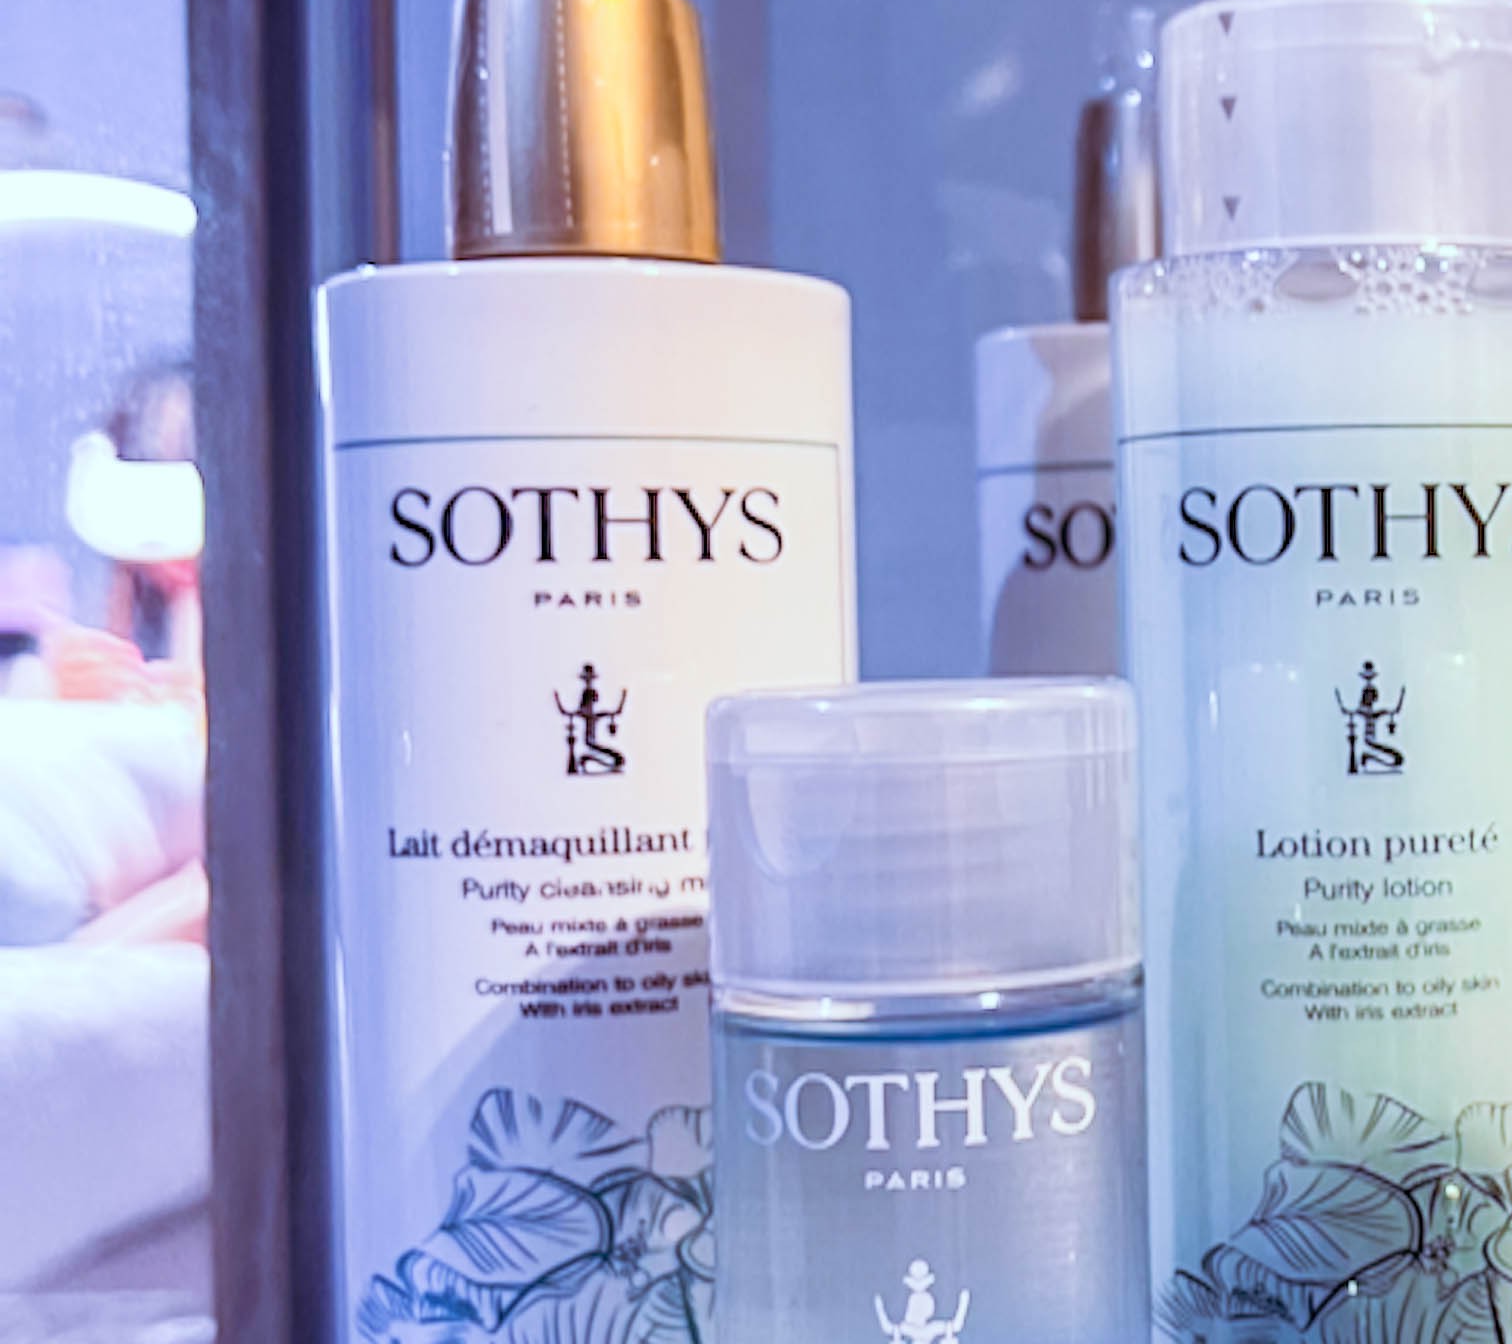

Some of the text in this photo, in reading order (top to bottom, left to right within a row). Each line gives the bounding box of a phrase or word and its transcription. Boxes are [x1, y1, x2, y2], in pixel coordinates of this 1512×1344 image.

[390, 486, 784, 567] SOTHYS
[1022, 501, 1116, 570] SO
[534, 591, 641, 607] PARIS
[1316, 589, 1420, 607] PARIS
[389, 827, 692, 863] Lait démaquillant
[1257, 822, 1499, 863] Lotion pureté
[463, 877, 530, 903] Purity
[1304, 877, 1453, 904] Purity lotion
[492, 918, 543, 935] Peau
[635, 915, 703, 935] grasse
[1277, 920, 1327, 936] Peau
[1397, 919, 1408, 935] à
[1416, 918, 1481, 936] grasse
[525, 943, 539, 957] A
[1309, 945, 1324, 960] A
[475, 970, 710, 996] Combination to oily ski
[1261, 974, 1499, 998] Combination to oily skin
[520, 997, 679, 1019] With iris extract
[1304, 1001, 1458, 1021] With iris extract
[743, 1056, 1096, 1150] SOTHYS
[864, 1167, 967, 1191] PARIS
